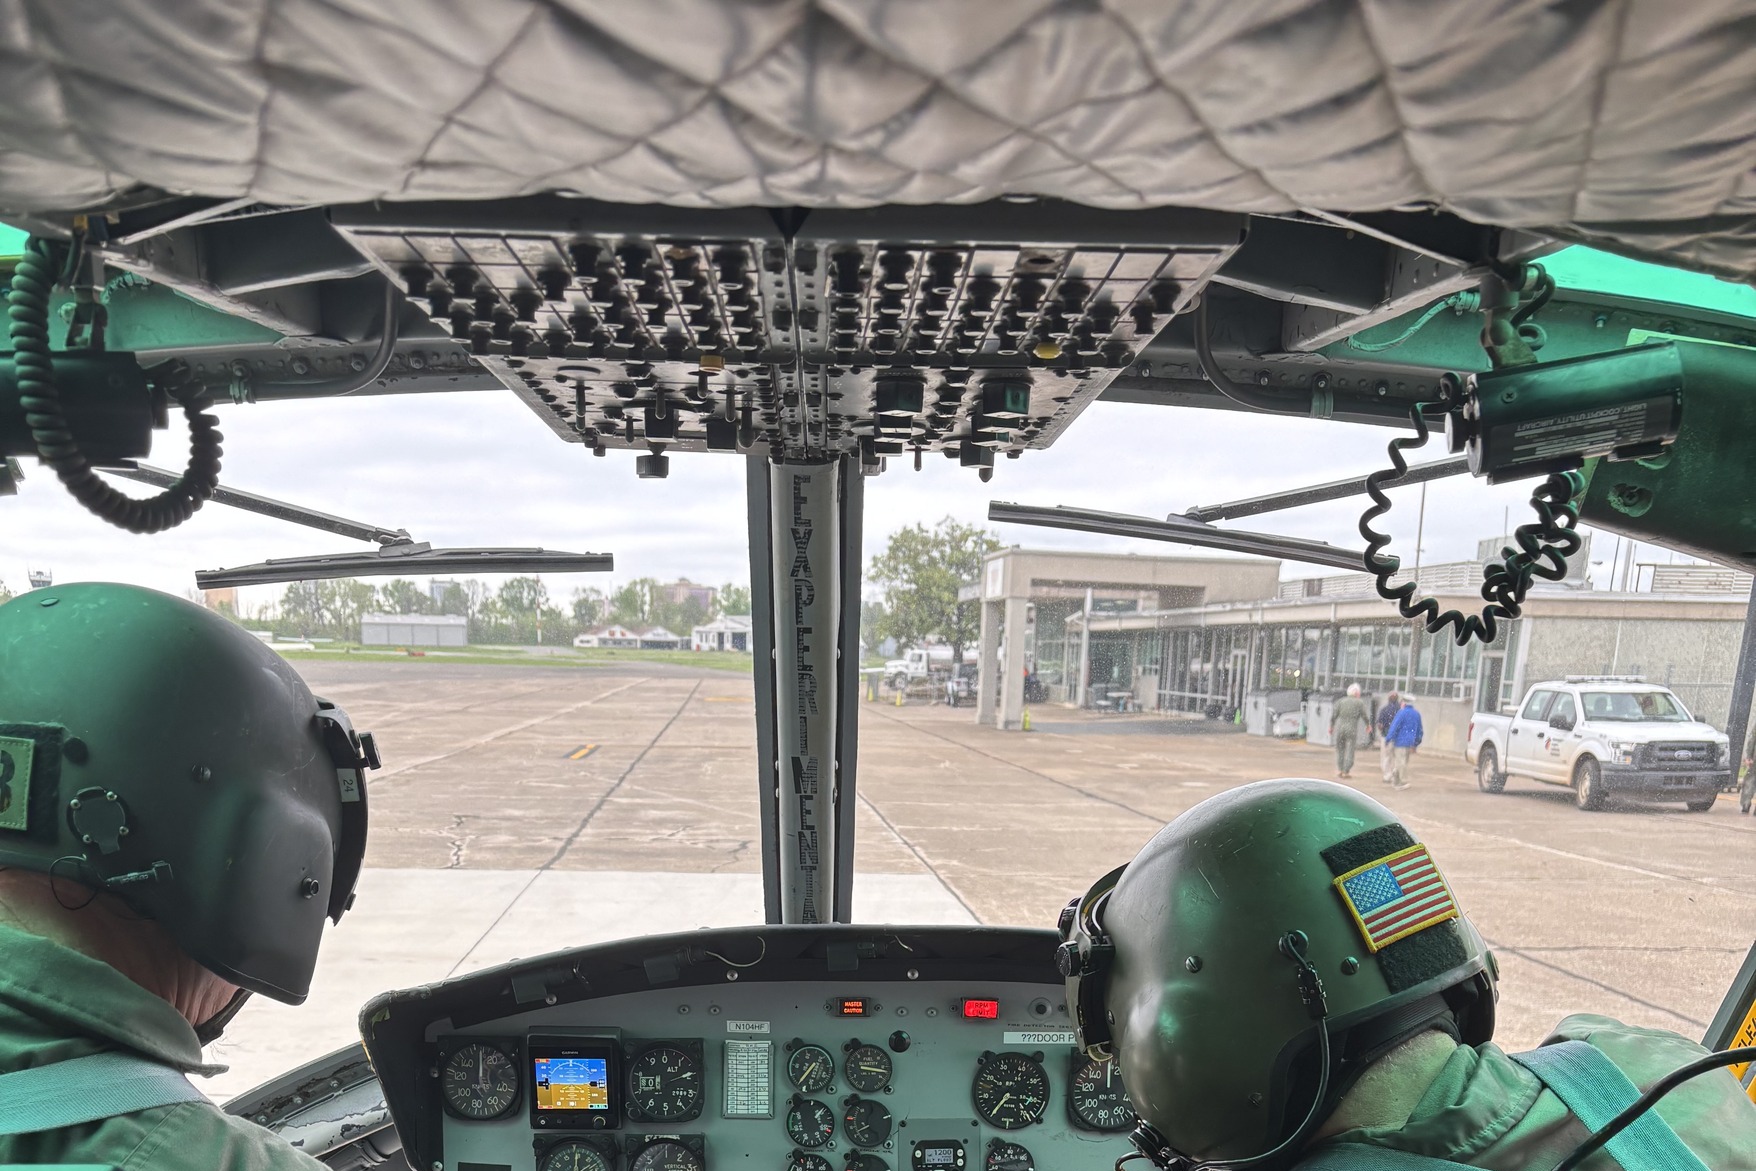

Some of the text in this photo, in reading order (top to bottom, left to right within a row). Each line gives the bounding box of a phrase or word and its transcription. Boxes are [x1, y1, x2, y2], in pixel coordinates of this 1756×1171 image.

[789, 474, 819, 924] EXPERIMENTA
[735, 1023, 765, 1031] N104HF
[1081, 1082, 1095, 1091] 120
[471, 1099, 483, 1109] 80
[487, 1096, 499, 1105] 60
[1085, 1098, 1098, 1107] 100
[663, 1102, 669, 1111] 5
[1113, 1106, 1125, 1115] 60
[1098, 1109, 1109, 1118] 80
[676, 1154, 683, 1163] 2
